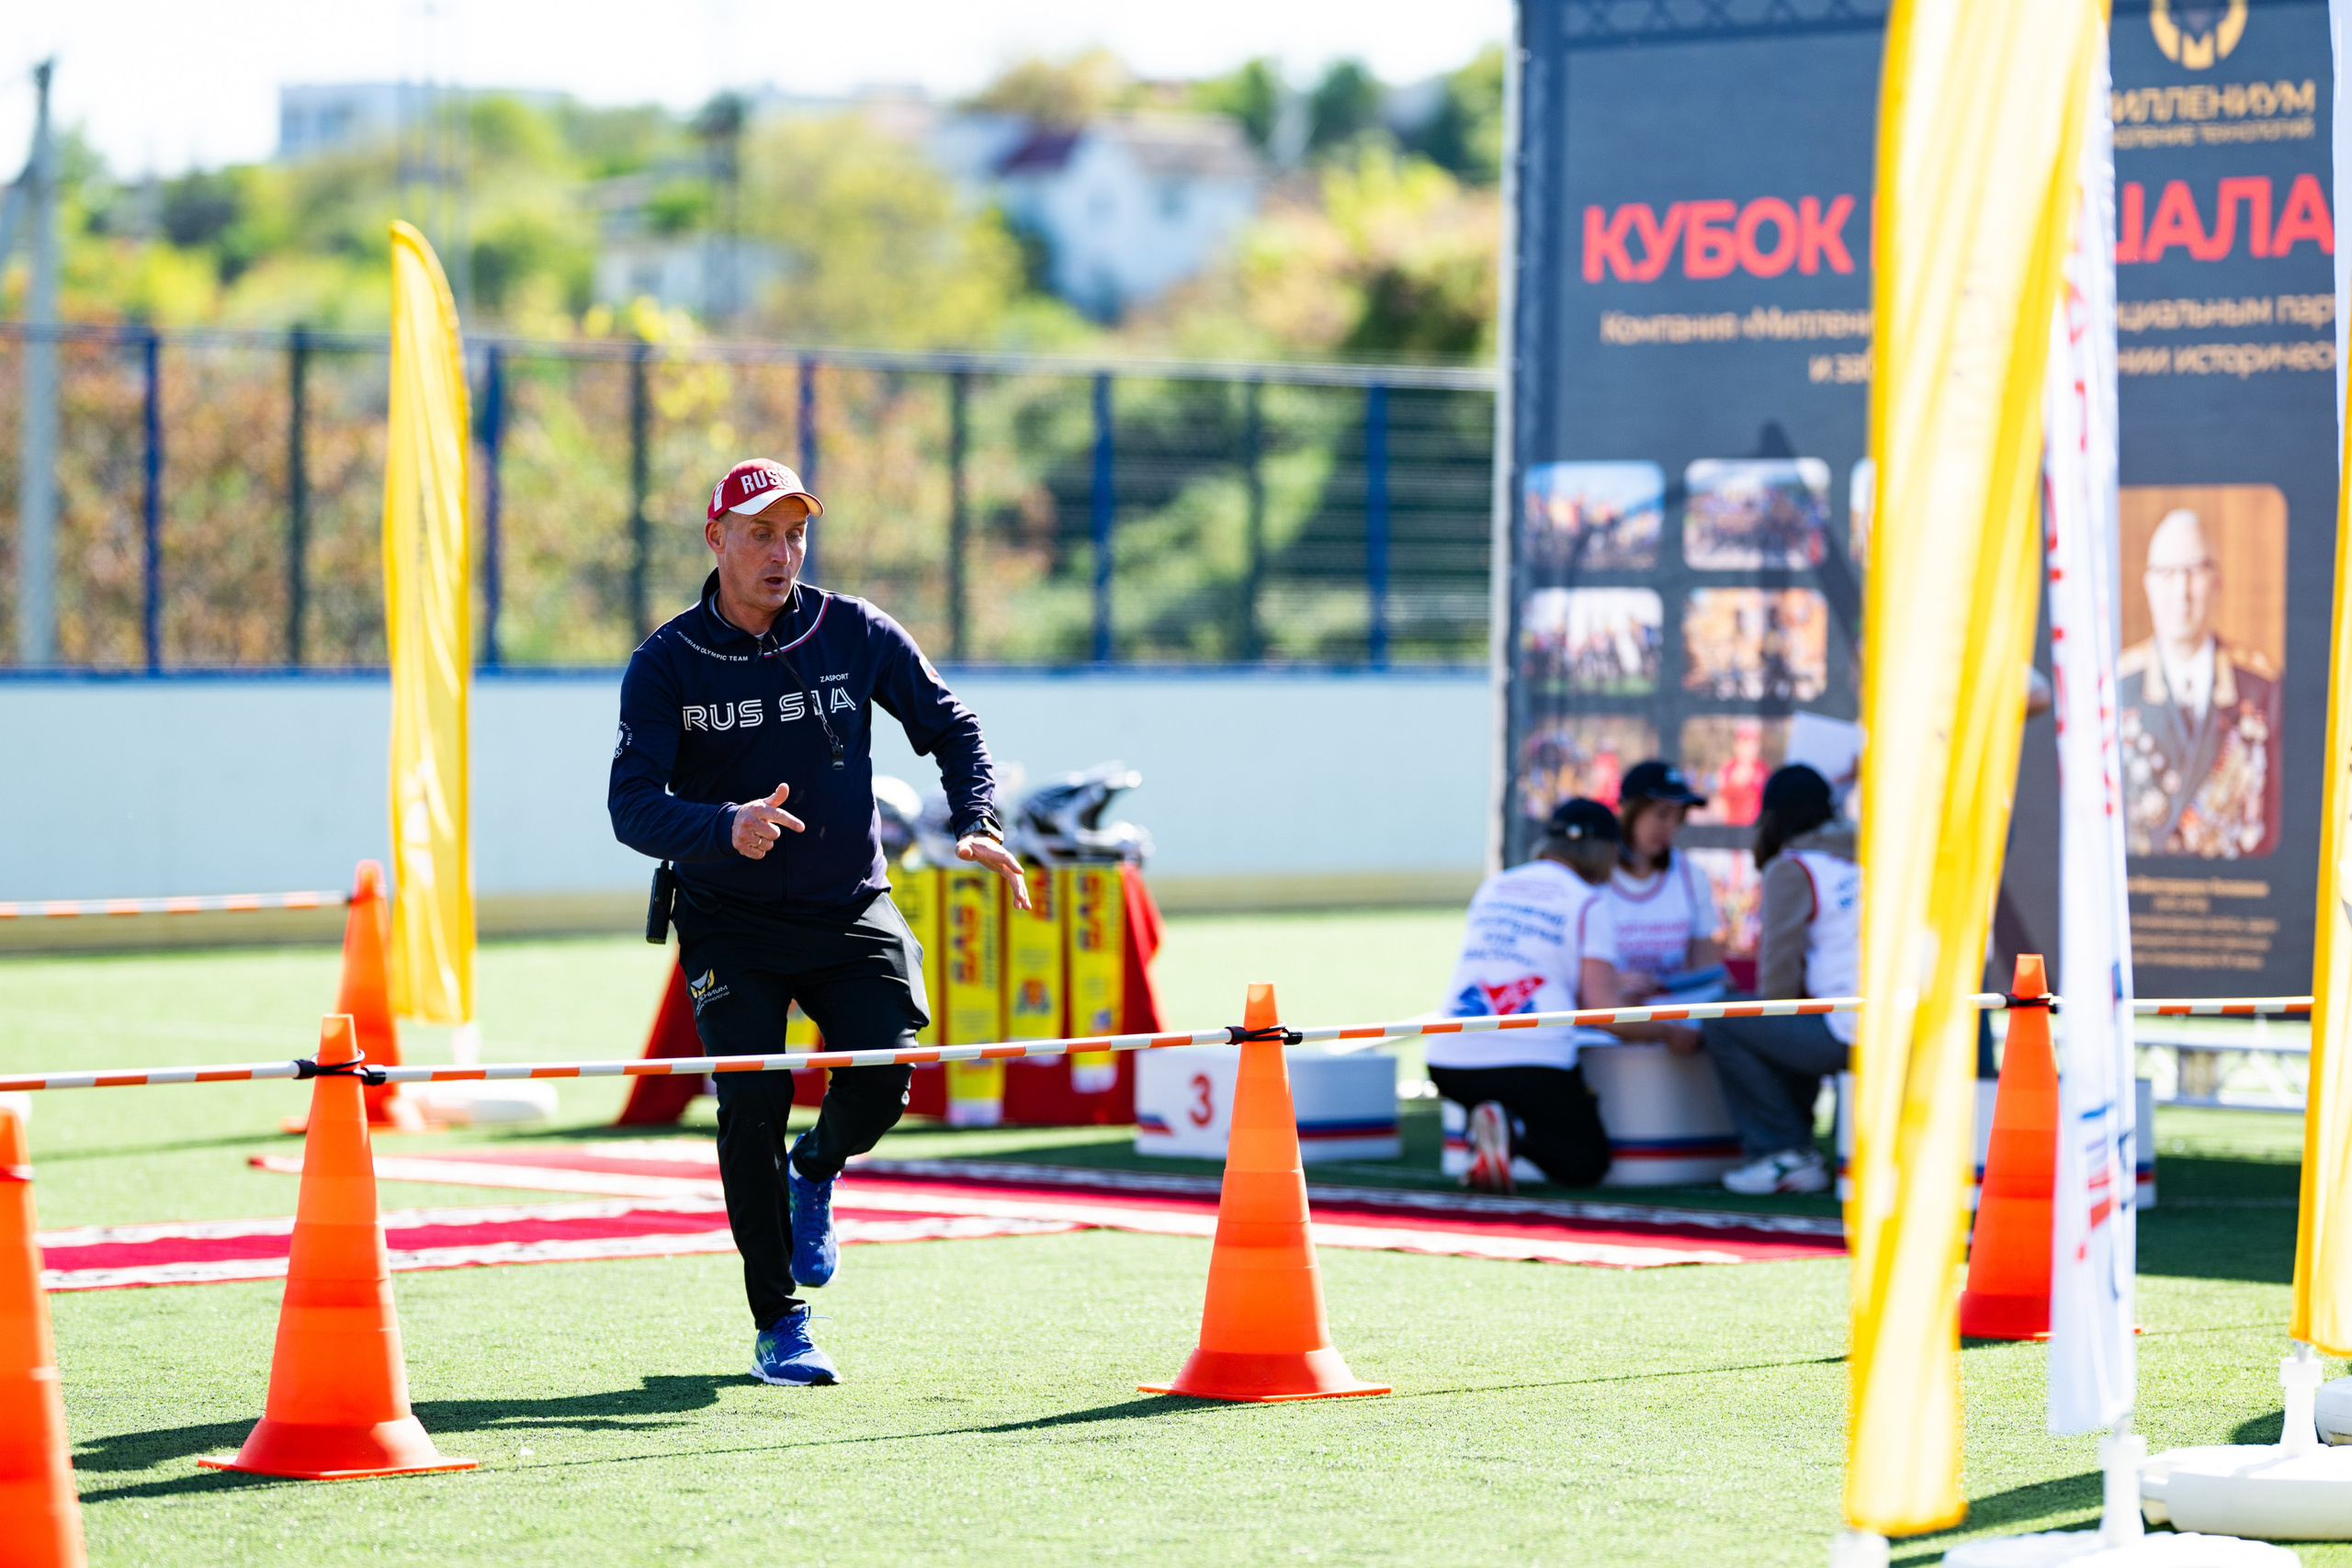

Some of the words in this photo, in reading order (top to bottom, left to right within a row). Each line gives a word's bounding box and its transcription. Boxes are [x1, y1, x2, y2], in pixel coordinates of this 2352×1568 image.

[2110, 80, 2315, 123] ИЛЛЕНИУМ
[1582, 194, 1856, 283] КУБОК
[1600, 310, 1739, 345] Компания
[2116, 297, 2273, 334] циальным
[2174, 341, 2336, 379] историчес
[676, 630, 700, 651] RUSSIAN
[700, 647, 728, 660] OLYMPIC
[820, 672, 849, 682] ZASPORT
[1189, 1072, 1216, 1128] 3
